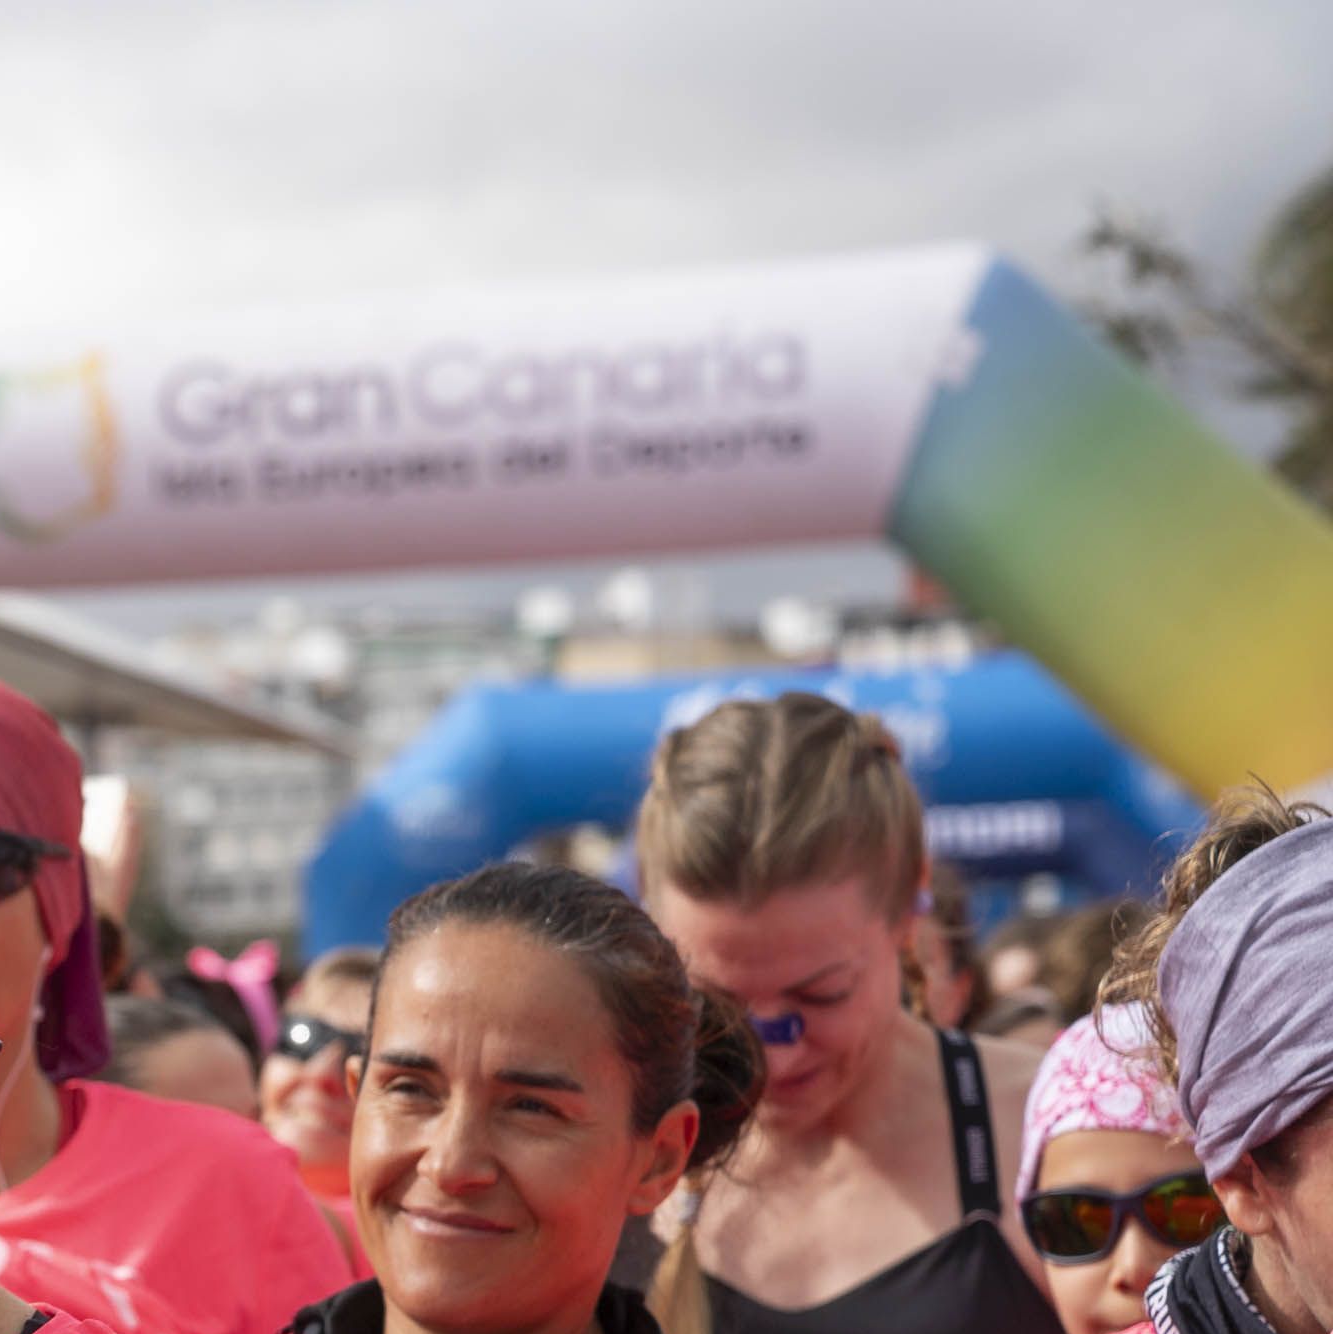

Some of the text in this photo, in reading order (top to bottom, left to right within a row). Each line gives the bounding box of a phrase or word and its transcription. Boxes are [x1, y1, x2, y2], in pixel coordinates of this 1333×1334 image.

[157, 326, 809, 446] Gran Canaria
[256, 442, 476, 501] Europea
[492, 432, 570, 485] del
[592, 416, 814, 480] Deporte
